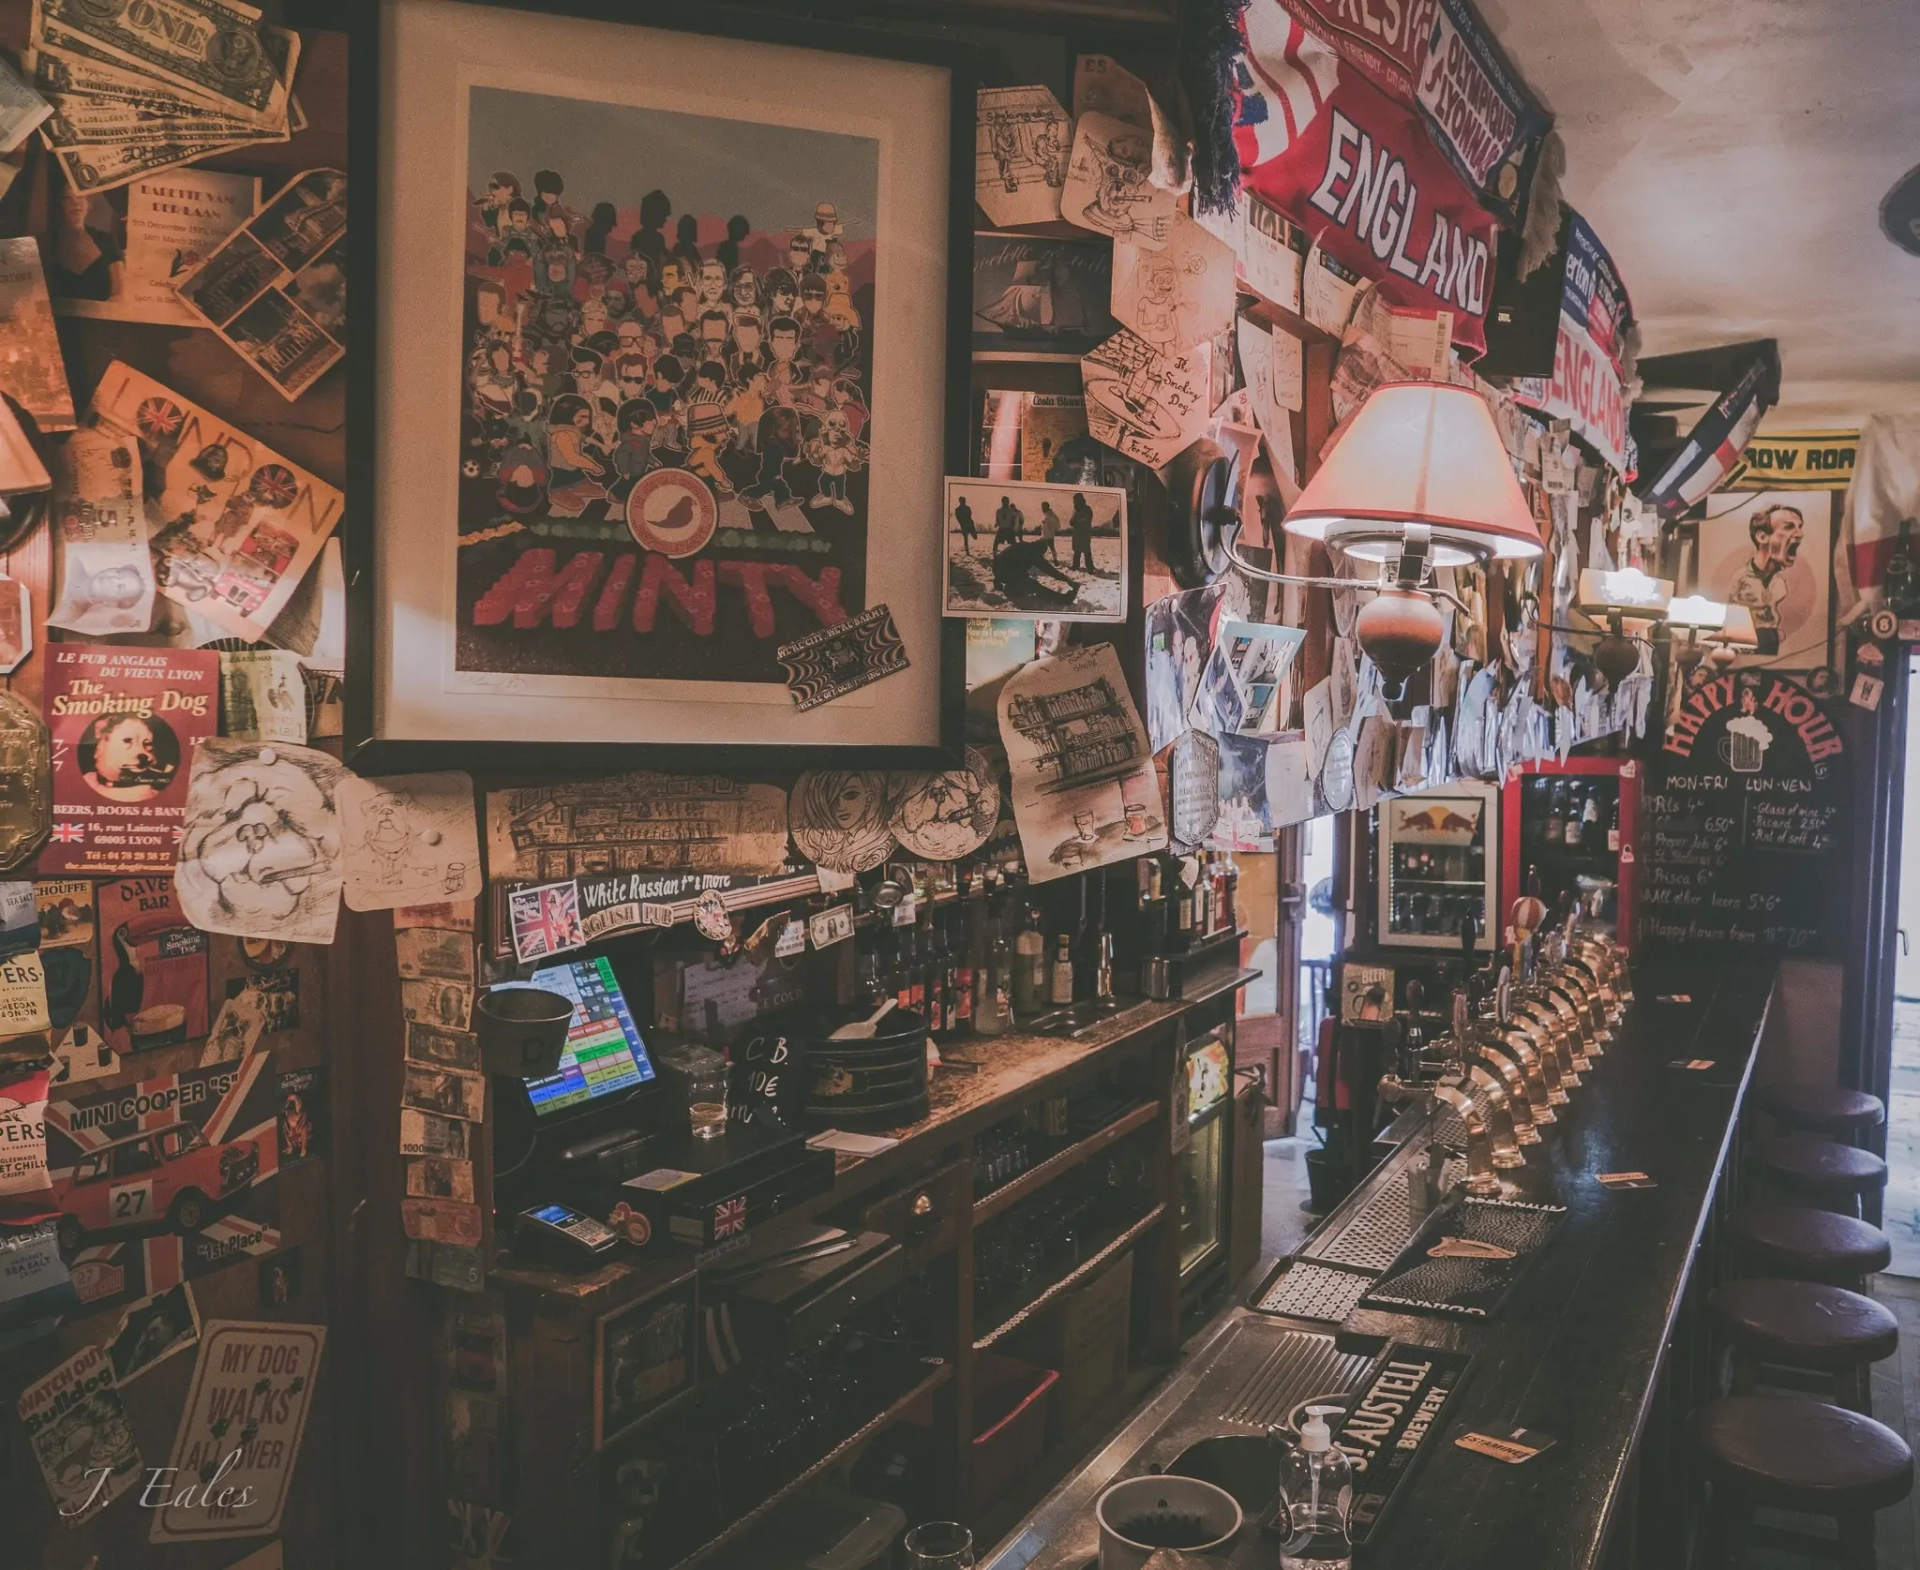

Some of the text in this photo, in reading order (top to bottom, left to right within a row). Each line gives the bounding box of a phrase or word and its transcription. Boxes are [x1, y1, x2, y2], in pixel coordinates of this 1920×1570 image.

[127, 2, 208, 54] ONE
[1446, 31, 1516, 144] OLYMPIQUE
[1433, 72, 1504, 183] LYONNAIS
[1309, 104, 1489, 317] ENGLAND
[1163, 370, 1204, 404] Smoking
[1551, 328, 1624, 455] ENGLAND
[1033, 394, 1055, 407] Costa
[1167, 393, 1194, 417] Dog
[472, 547, 852, 640] MINTY
[56, 652, 169, 668] LE PUB ANGLAIS
[99, 667, 204, 681] DU VIEUX LYON
[68, 678, 104, 695] The
[51, 689, 209, 719] Smoking Dog
[1662, 673, 1737, 758] HAPPY
[1761, 679, 1844, 763] HOUR
[1665, 774, 1729, 791] MON-FRI
[52, 804, 95, 817] BEERS,
[96, 804, 140, 817] BOOKS
[141, 805, 153, 816] &
[87, 822, 171, 834] 16, rue Lainerie
[128, 835, 163, 846] LYON
[1653, 867, 1692, 886] Prisca
[20, 892, 33, 903] SALT
[33, 882, 88, 898] CHOUFFE
[582, 877, 627, 909] White
[628, 873, 680, 900] Russian
[702, 874, 731, 890] more
[139, 895, 170, 911] BAR
[643, 904, 673, 926] PUB
[170, 933, 184, 942] The
[1651, 916, 1688, 943] Happy
[1689, 919, 1726, 940] hours
[166, 935, 201, 951] Smoking
[180, 945, 197, 955] Dog
[1360, 967, 1386, 985] BEER
[7, 1008, 37, 1018] ONION
[69, 1072, 240, 1132] MINI COOPER "S"
[402, 1144, 425, 1152] 1000
[114, 1190, 148, 1219] 27
[468, 1268, 478, 1282] 5
[220, 1342, 301, 1375] MY DOG
[18, 1366, 75, 1415] WATCH
[22, 1367, 113, 1438] Bulldog
[207, 1387, 293, 1425] WALKS
[1342, 1360, 1433, 1448] AUSTELL
[1395, 1385, 1449, 1451] BREWERY
